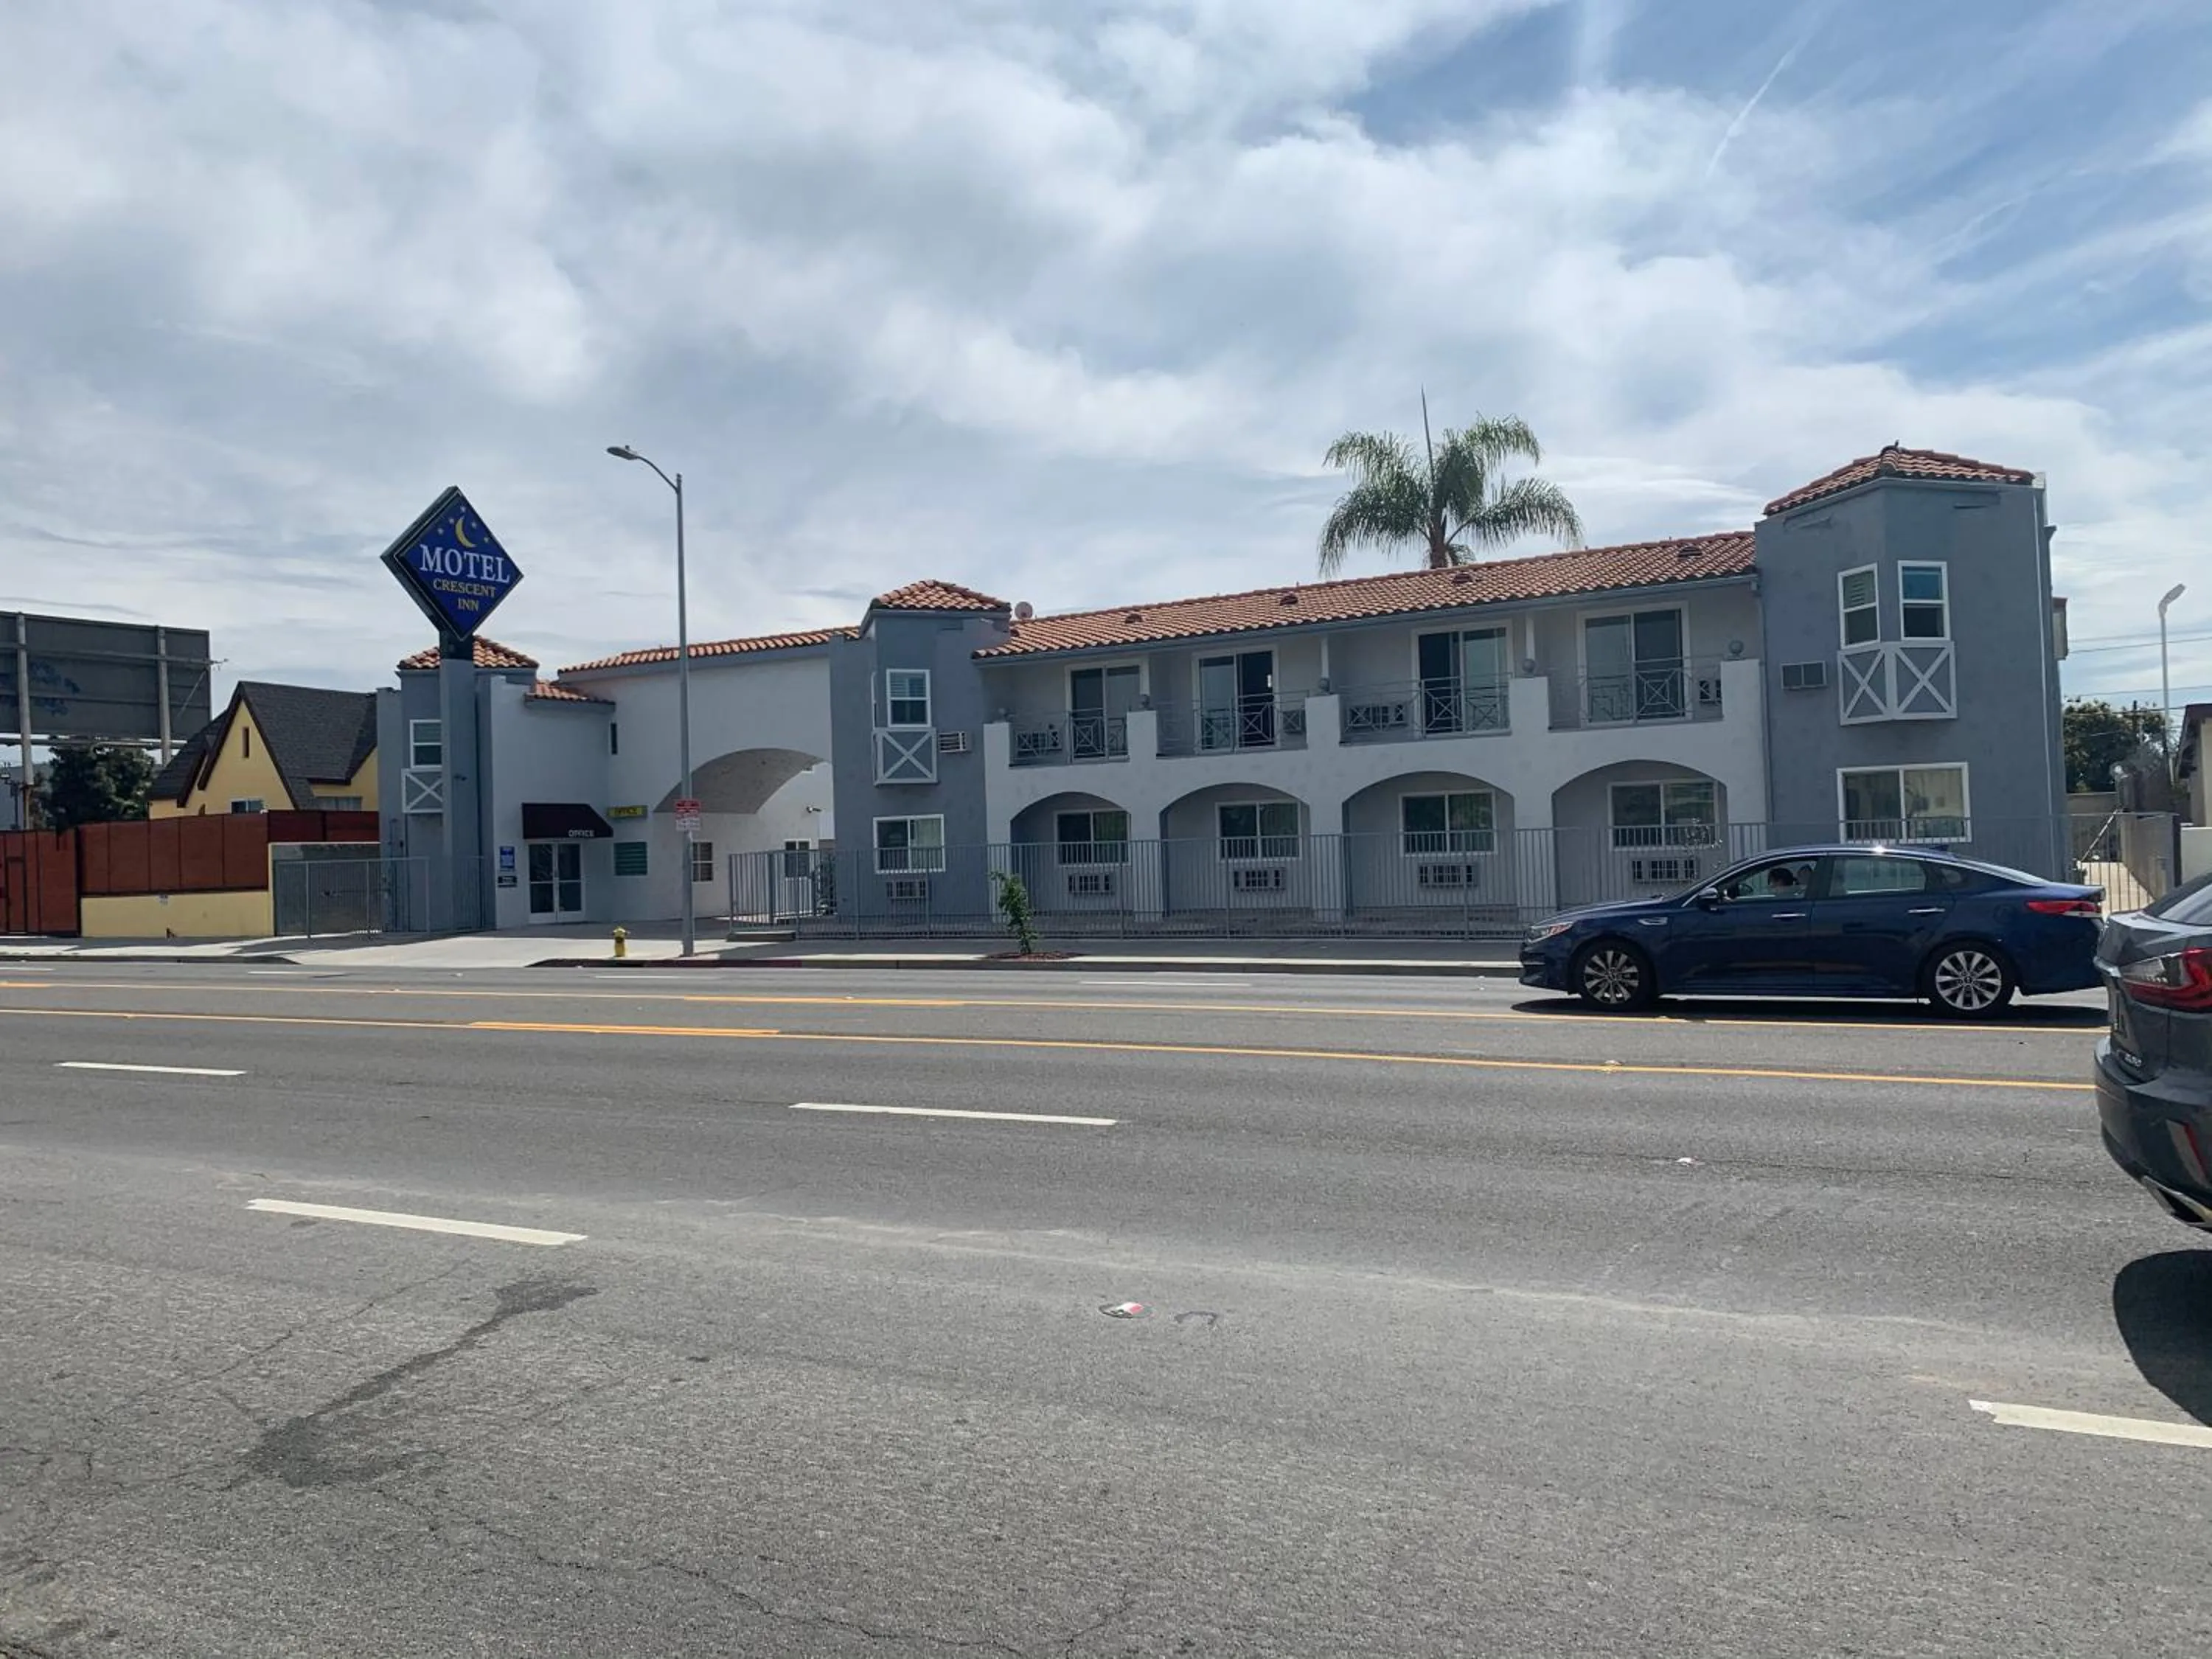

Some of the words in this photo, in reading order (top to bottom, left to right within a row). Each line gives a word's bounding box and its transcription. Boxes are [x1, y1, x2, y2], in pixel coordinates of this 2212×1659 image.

[420, 544, 510, 583] MOTEL
[433, 578, 495, 598] CRESCENT
[458, 598, 479, 611] INN
[568, 830, 594, 838] OFFICE
